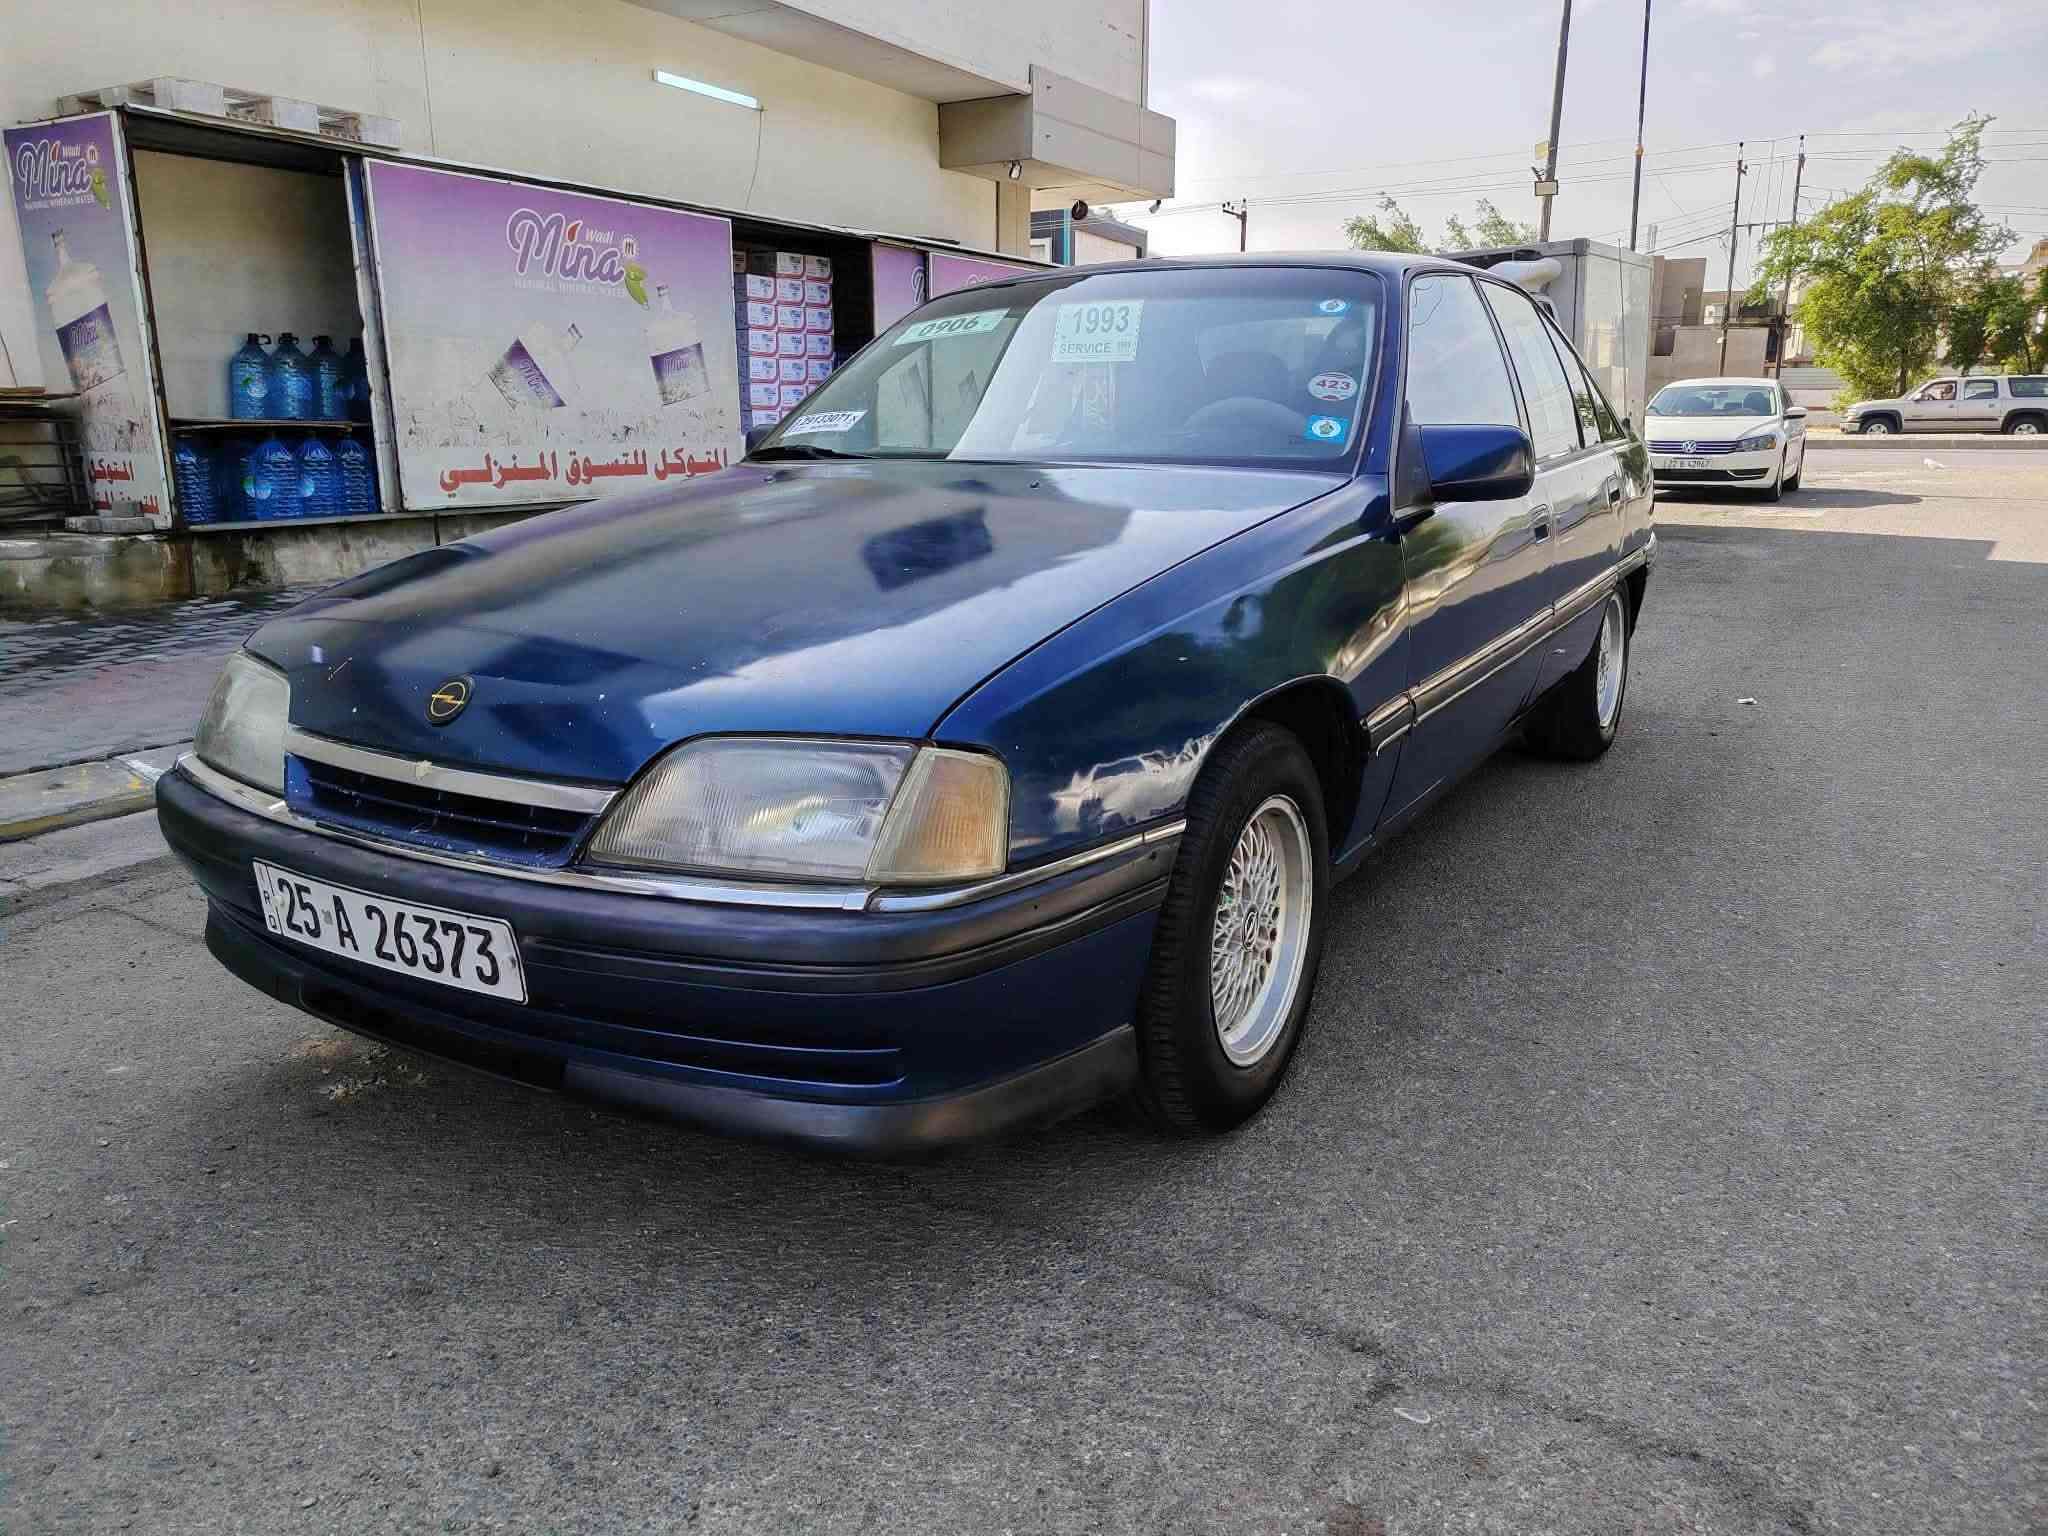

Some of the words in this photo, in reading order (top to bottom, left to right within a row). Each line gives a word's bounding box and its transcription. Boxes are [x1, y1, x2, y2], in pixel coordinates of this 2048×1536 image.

[17, 139, 92, 200] Mina
[507, 207, 625, 286] Mina
[918, 315, 978, 337] 0906
[1072, 305, 1130, 334] 1993
[1060, 342, 1113, 354] SERVICE
[1315, 379, 1351, 391] 423
[439, 450, 558, 498] المنزلي
[565, 449, 648, 487] للتسوق
[654, 448, 728, 481] التوكل
[277, 878, 322, 938] 25
[332, 894, 360, 952] A
[364, 904, 500, 986] 26373
